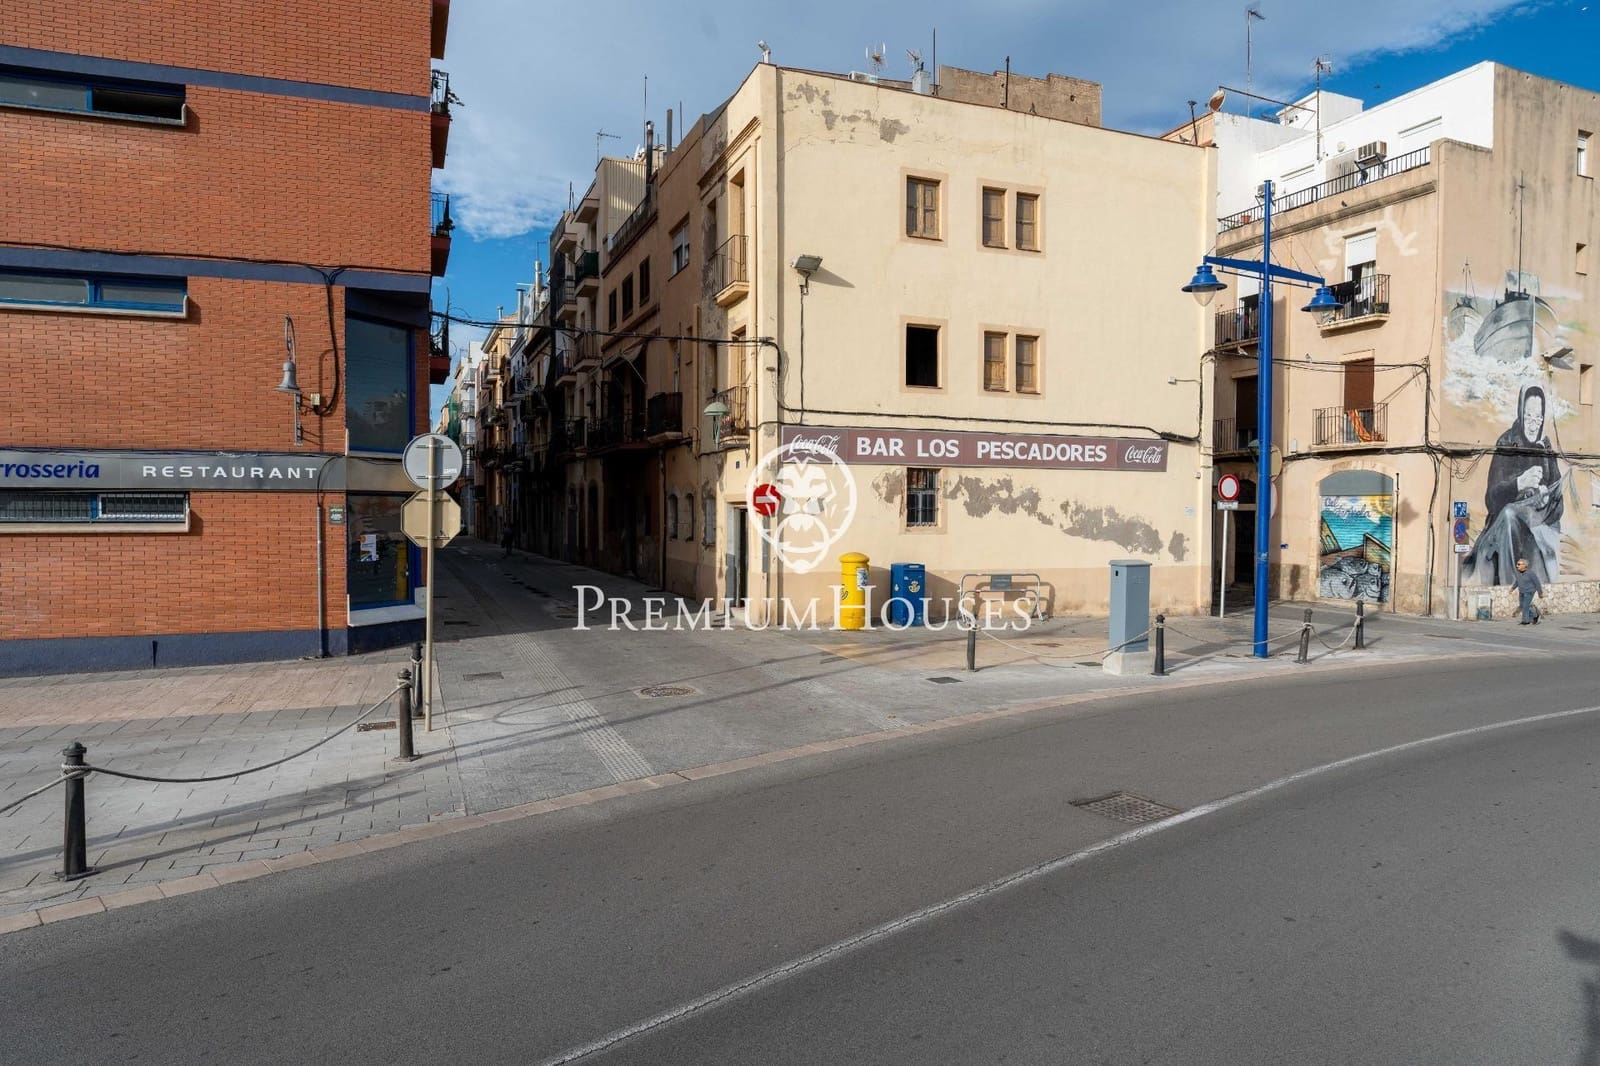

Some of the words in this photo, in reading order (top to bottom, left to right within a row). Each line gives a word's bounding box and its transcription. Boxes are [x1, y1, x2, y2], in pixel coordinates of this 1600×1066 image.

[856, 437, 905, 456] BAR
[917, 438, 960, 458] LOS
[977, 440, 1107, 462] PESCADORES
[142, 465, 318, 479] RESTAURANT
